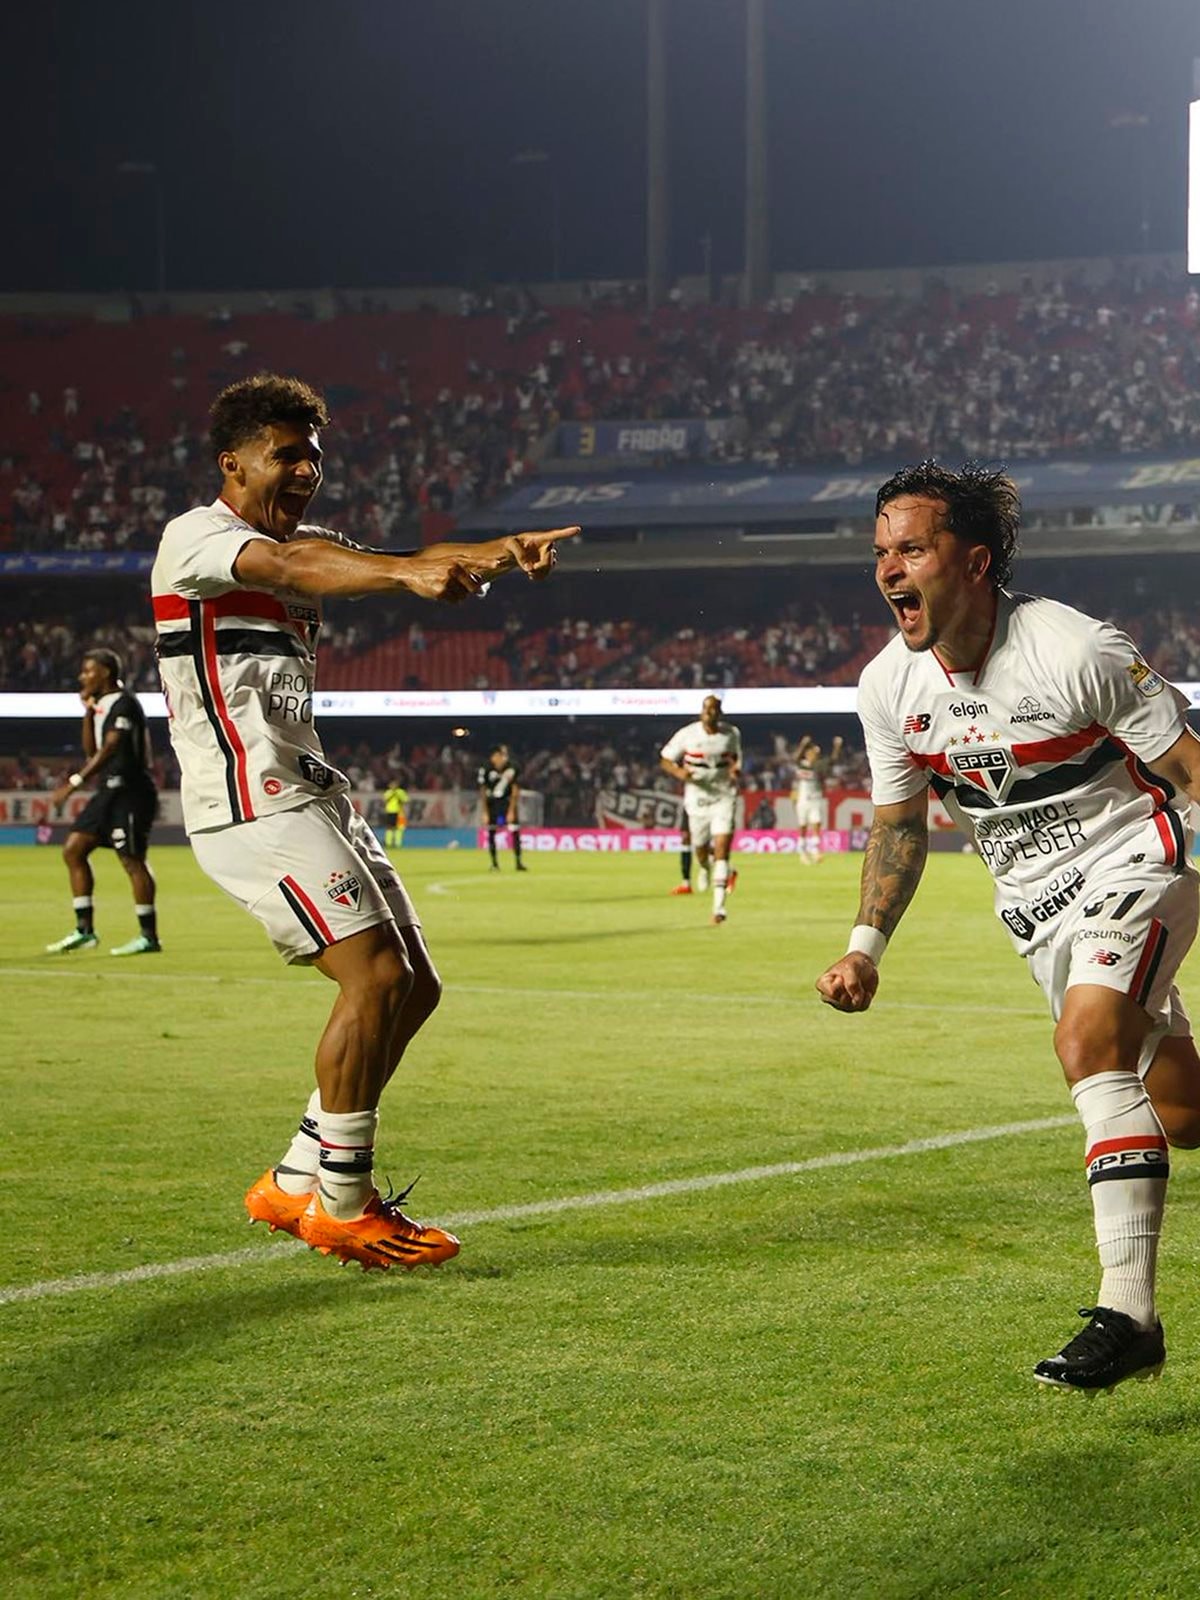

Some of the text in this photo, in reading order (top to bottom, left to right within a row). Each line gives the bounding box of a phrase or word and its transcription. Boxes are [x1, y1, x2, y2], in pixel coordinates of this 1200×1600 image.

[578, 427, 596, 455] 3
[952, 701, 989, 719] elgin
[955, 753, 1004, 769] SPFC
[329, 878, 359, 899] SPFC
